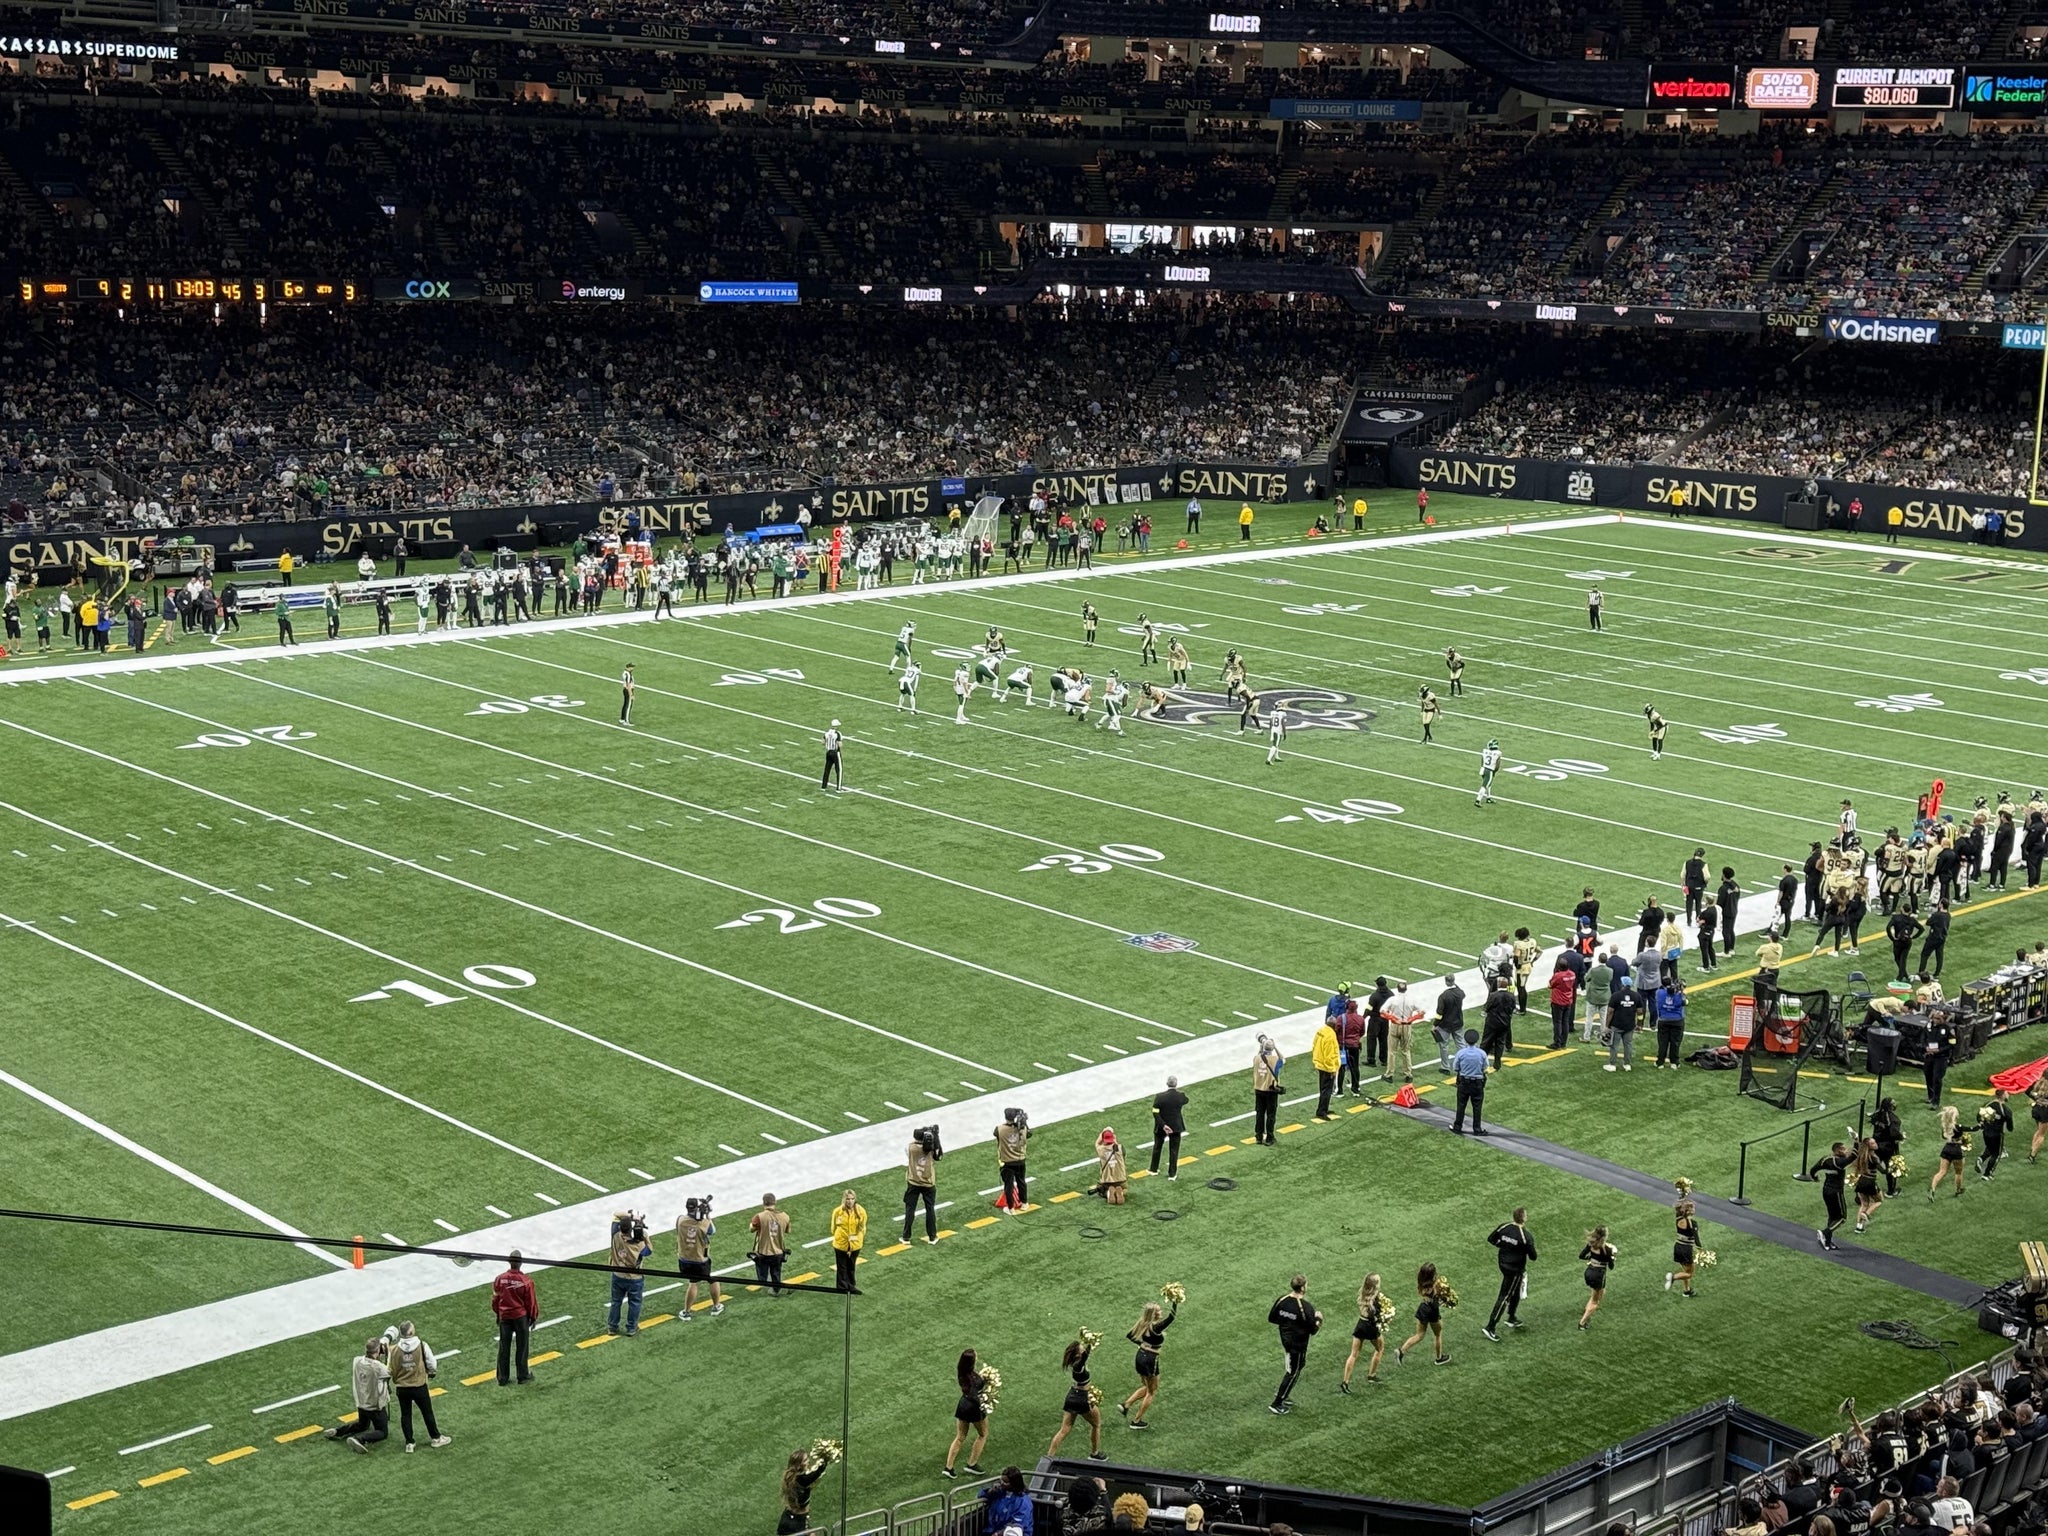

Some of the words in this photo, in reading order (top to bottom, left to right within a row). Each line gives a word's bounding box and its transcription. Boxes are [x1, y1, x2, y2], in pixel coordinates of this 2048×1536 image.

[294, 0, 348, 15] SAINTS
[414, 7, 467, 24] SAINTS
[529, 15, 580, 32] SAINTS
[1209, 14, 1261, 33] LOUDER
[641, 24, 690, 40] SAINTS
[86, 42, 179, 60] SUPERDOME
[224, 51, 276, 66] SAINTS
[339, 58, 390, 73] SAINTS
[449, 65, 497, 79] SAINTS
[556, 71, 604, 85] SAINTS
[660, 77, 707, 90] SAINTS
[1762, 72, 1803, 86] 50/50
[1837, 68, 1895, 84] CURRENT
[1896, 69, 1954, 85] JACKPOT
[1996, 76, 2047, 89] Keesler
[762, 82, 807, 96] SAINTS
[861, 87, 905, 101] SAINTS
[1653, 78, 1731, 97] verizon
[1754, 86, 1809, 98] RAFFLE
[959, 92, 1005, 105] SAINTS
[1060, 95, 1107, 108] SAINTS
[1864, 87, 1918, 105] $80,060
[1995, 90, 2044, 102] Federal
[1164, 98, 1212, 111] SAINTS
[1357, 105, 1395, 116] LOUNGE
[1165, 266, 1210, 281] LOUDER
[22, 284, 32, 300] 3
[99, 281, 108, 296] 9
[122, 284, 131, 300] 2
[150, 285, 163, 299] 11
[176, 281, 214, 296] 13:03
[222, 285, 241, 300] 45
[256, 285, 264, 300] 3
[284, 282, 293, 297] 6
[345, 285, 354, 300] 3
[405, 280, 451, 299] COX
[485, 282, 533, 295] SAINTS
[577, 286, 625, 300] entergy
[715, 288, 755, 296] HANCOCK
[757, 288, 798, 296] WHITNEY
[905, 287, 942, 301] LOUDER
[1388, 301, 1406, 312] New
[1536, 305, 1577, 320] LOUDER
[1654, 313, 1675, 325] New
[1767, 313, 1819, 327] SAINTS
[1841, 320, 1937, 344] Ochsner
[1364, 390, 1405, 399] CAESARS
[1406, 392, 1454, 400] SUPERDOME
[1419, 457, 1516, 490] SAINTS
[1179, 469, 1288, 497] SAINTS
[1568, 474, 1593, 497] 20
[832, 486, 929, 518] SAINTS
[1647, 477, 1758, 512] SAINTS
[1904, 500, 2025, 538] SAINS
[720, 667, 806, 686] 40
[479, 694, 585, 714] 30
[1854, 693, 1945, 713] 30
[197, 725, 317, 747] 20
[1699, 725, 1788, 744] 40
[1484, 755, 1492, 766] 3
[1503, 758, 1610, 781] 50
[1302, 798, 1405, 824] 40
[1040, 843, 1166, 874] 30
[740, 897, 882, 934] 20
[1582, 937, 1594, 954] K
[378, 964, 537, 1007] 10
[1404, 1086, 1419, 1105] 20
